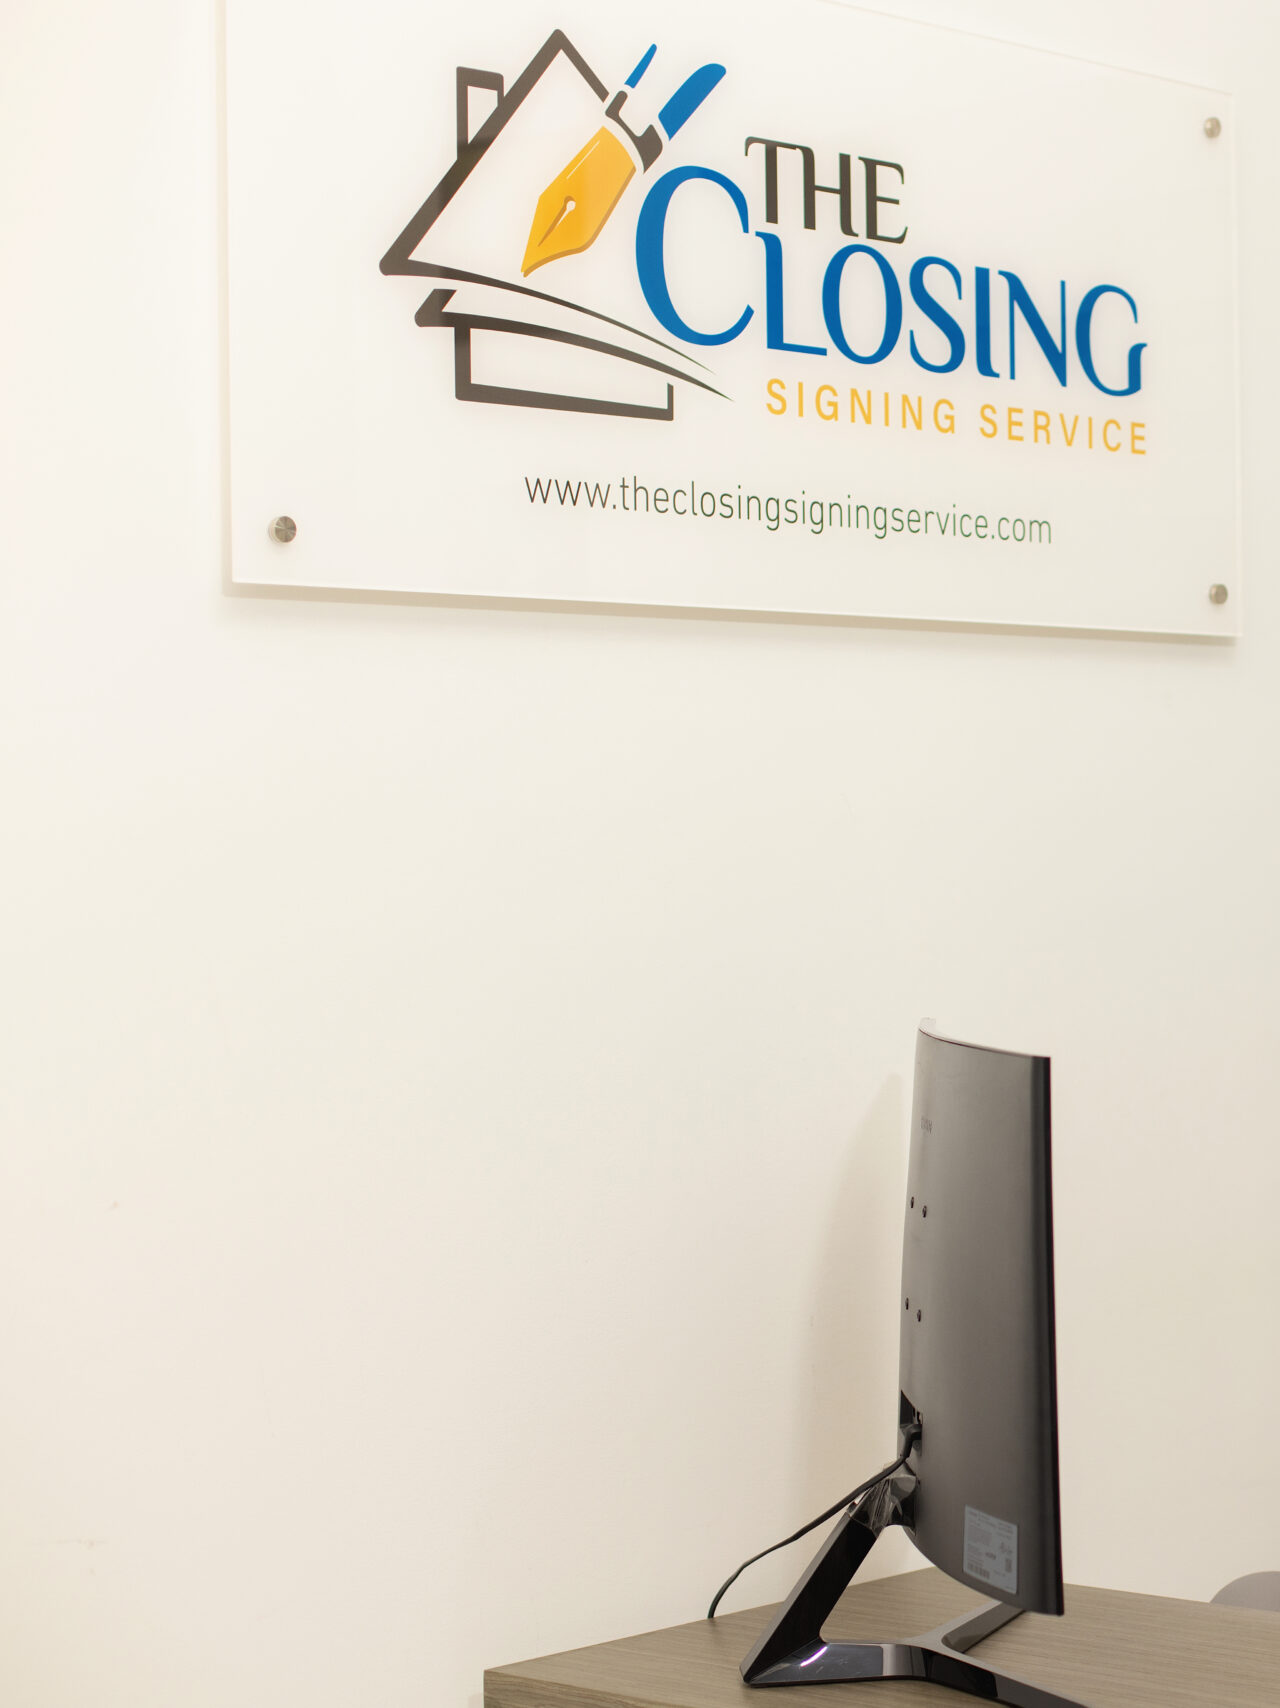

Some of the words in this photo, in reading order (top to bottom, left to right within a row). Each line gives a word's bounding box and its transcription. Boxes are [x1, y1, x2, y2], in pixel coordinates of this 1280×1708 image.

[744, 136, 909, 244] THE
[635, 165, 1148, 397] CLOSING
[766, 378, 957, 434] SIGNING
[979, 404, 1148, 456] SERVICE
[524, 474, 1053, 545] www.theclosingsigningservice.com
